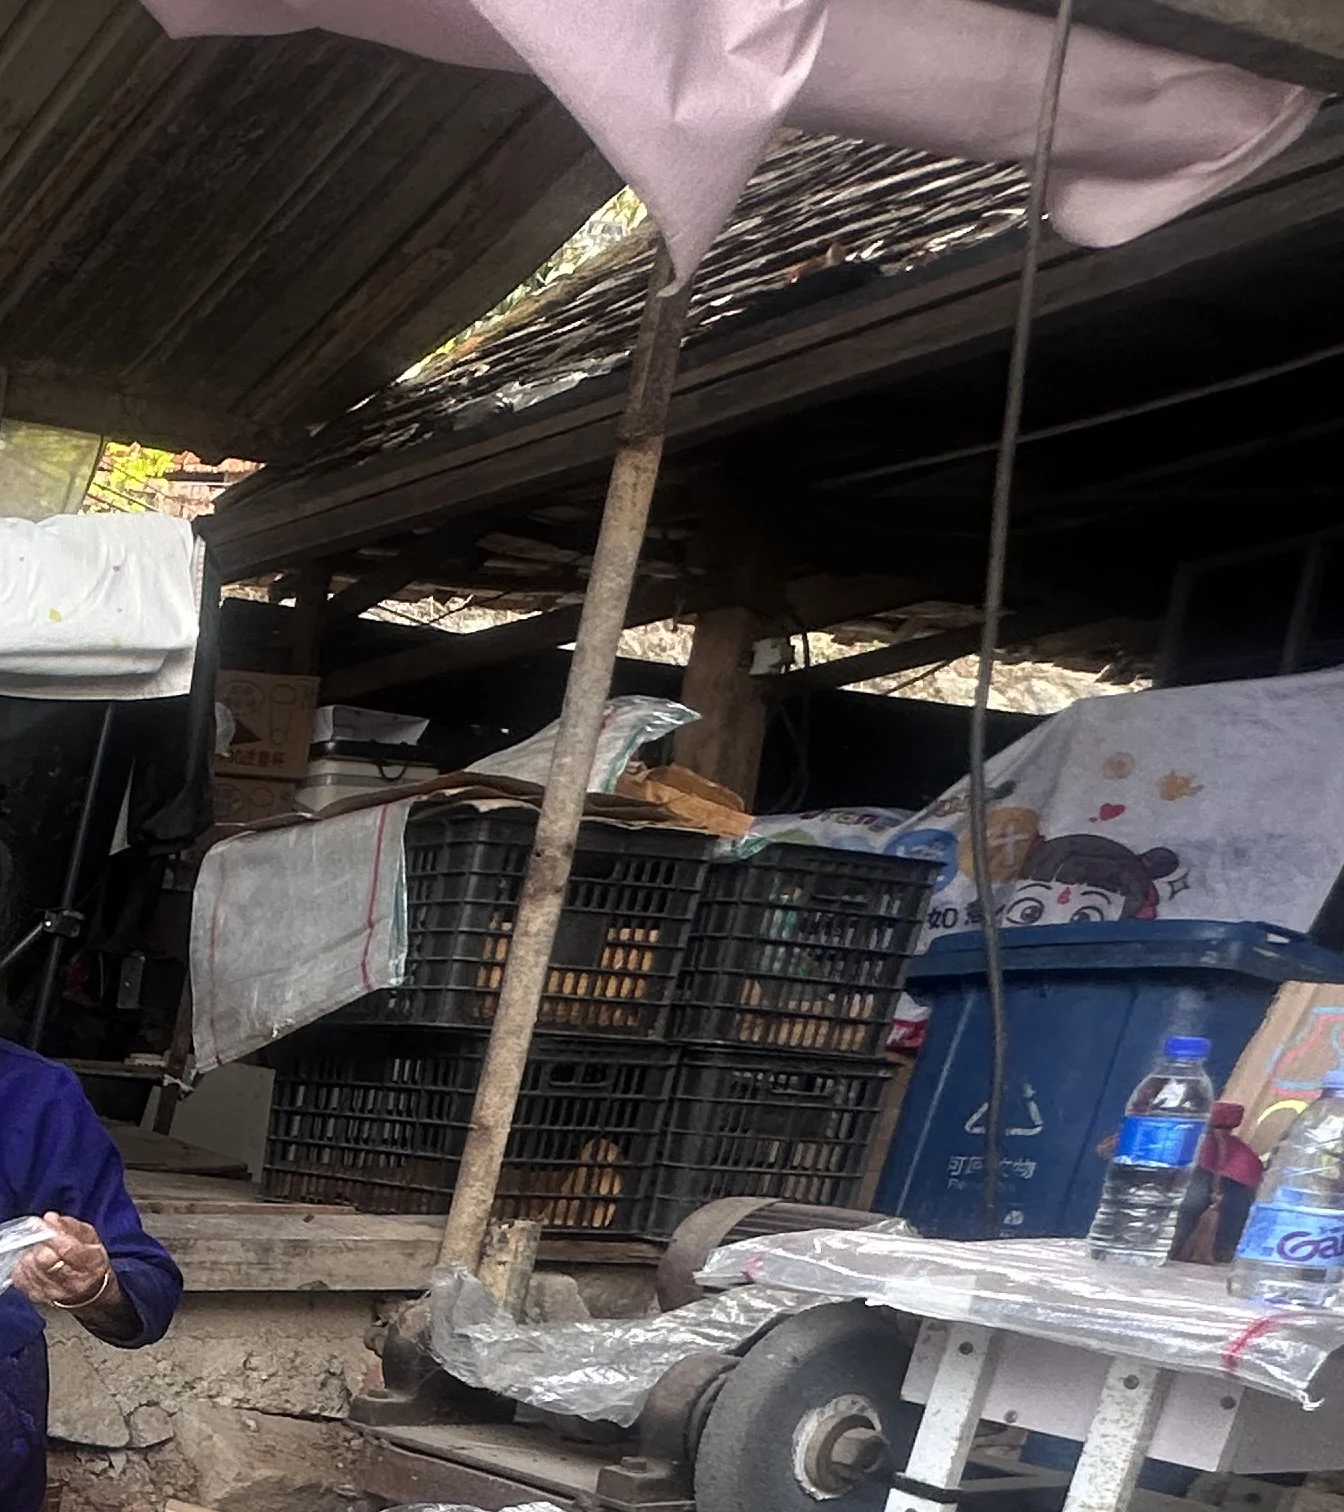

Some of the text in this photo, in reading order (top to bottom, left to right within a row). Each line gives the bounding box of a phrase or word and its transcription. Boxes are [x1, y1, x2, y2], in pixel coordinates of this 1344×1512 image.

[948, 1156, 1037, 1179] 可回物
[1276, 1231, 1344, 1262] Ga
